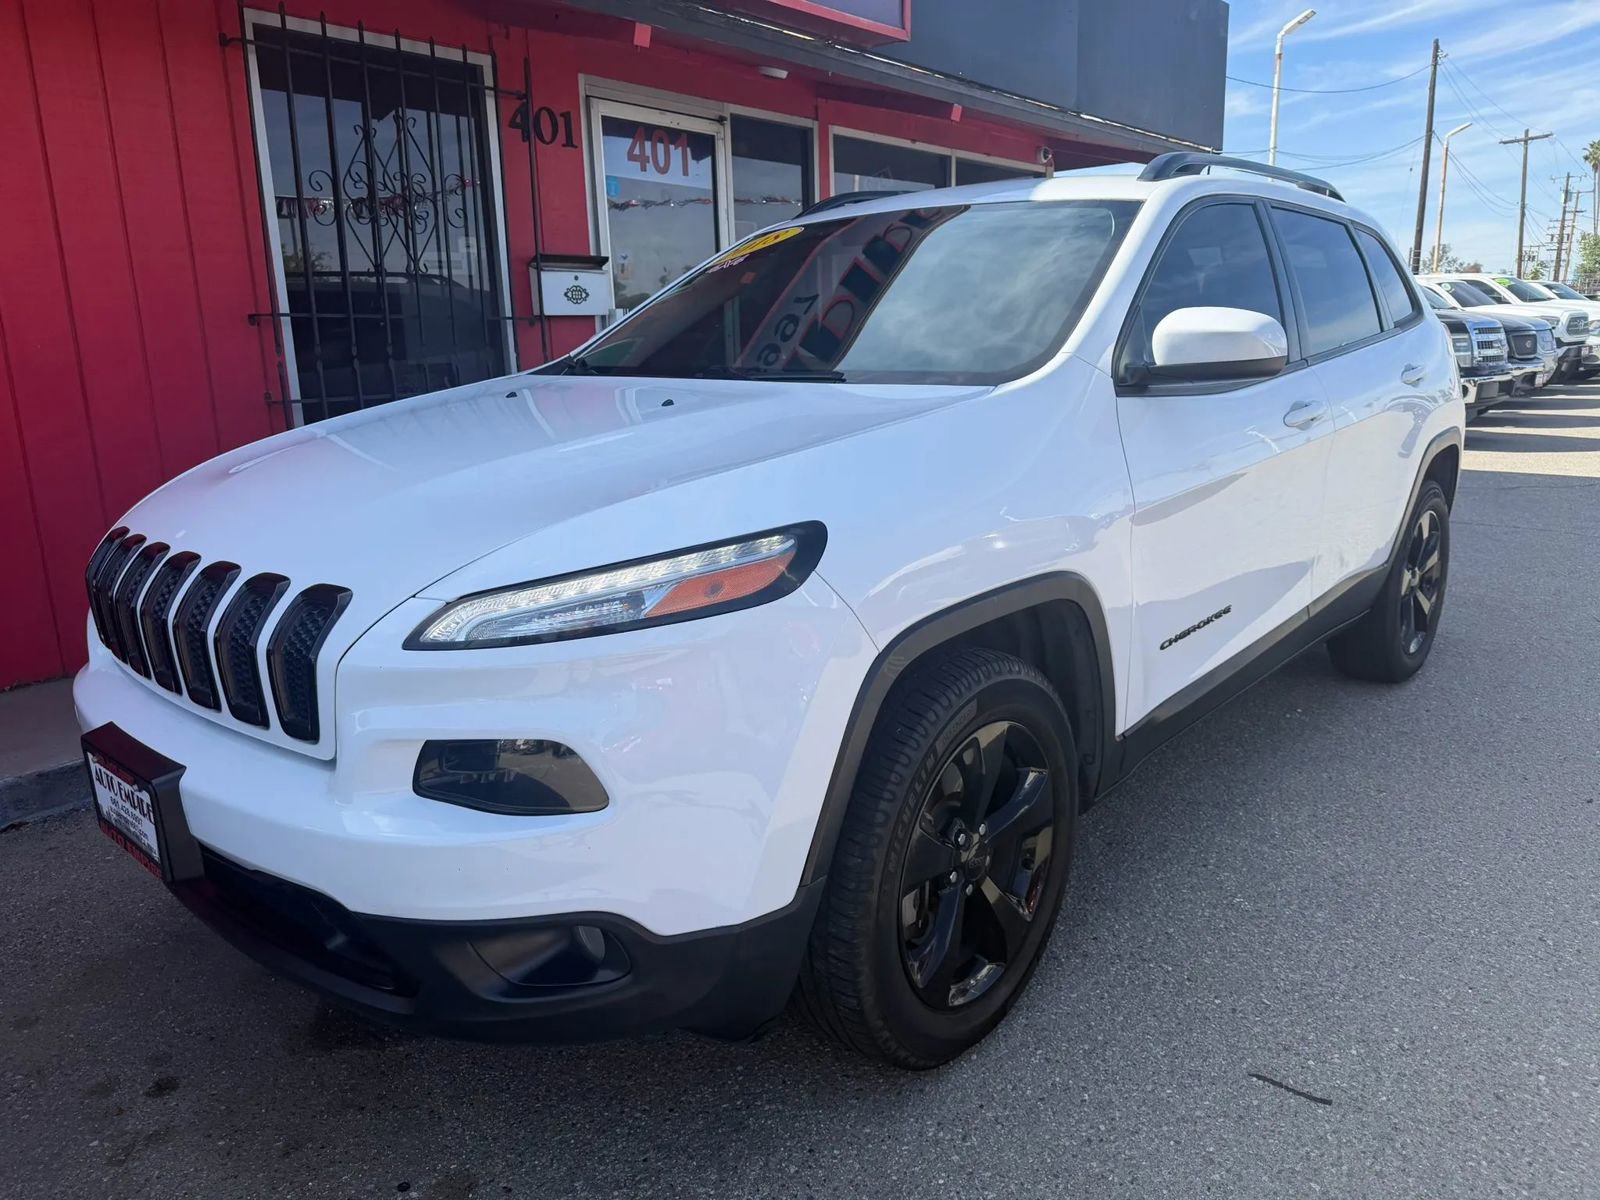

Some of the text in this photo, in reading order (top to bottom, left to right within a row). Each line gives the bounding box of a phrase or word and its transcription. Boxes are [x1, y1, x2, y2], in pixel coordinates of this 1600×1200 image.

[508, 99, 579, 149] 401
[626, 126, 690, 177] 401
[1159, 604, 1232, 651] CHEROKEE
[94, 764, 119, 797] AUTO
[117, 780, 155, 825] EMPIRE
[887, 752, 937, 873] MICHELIN
